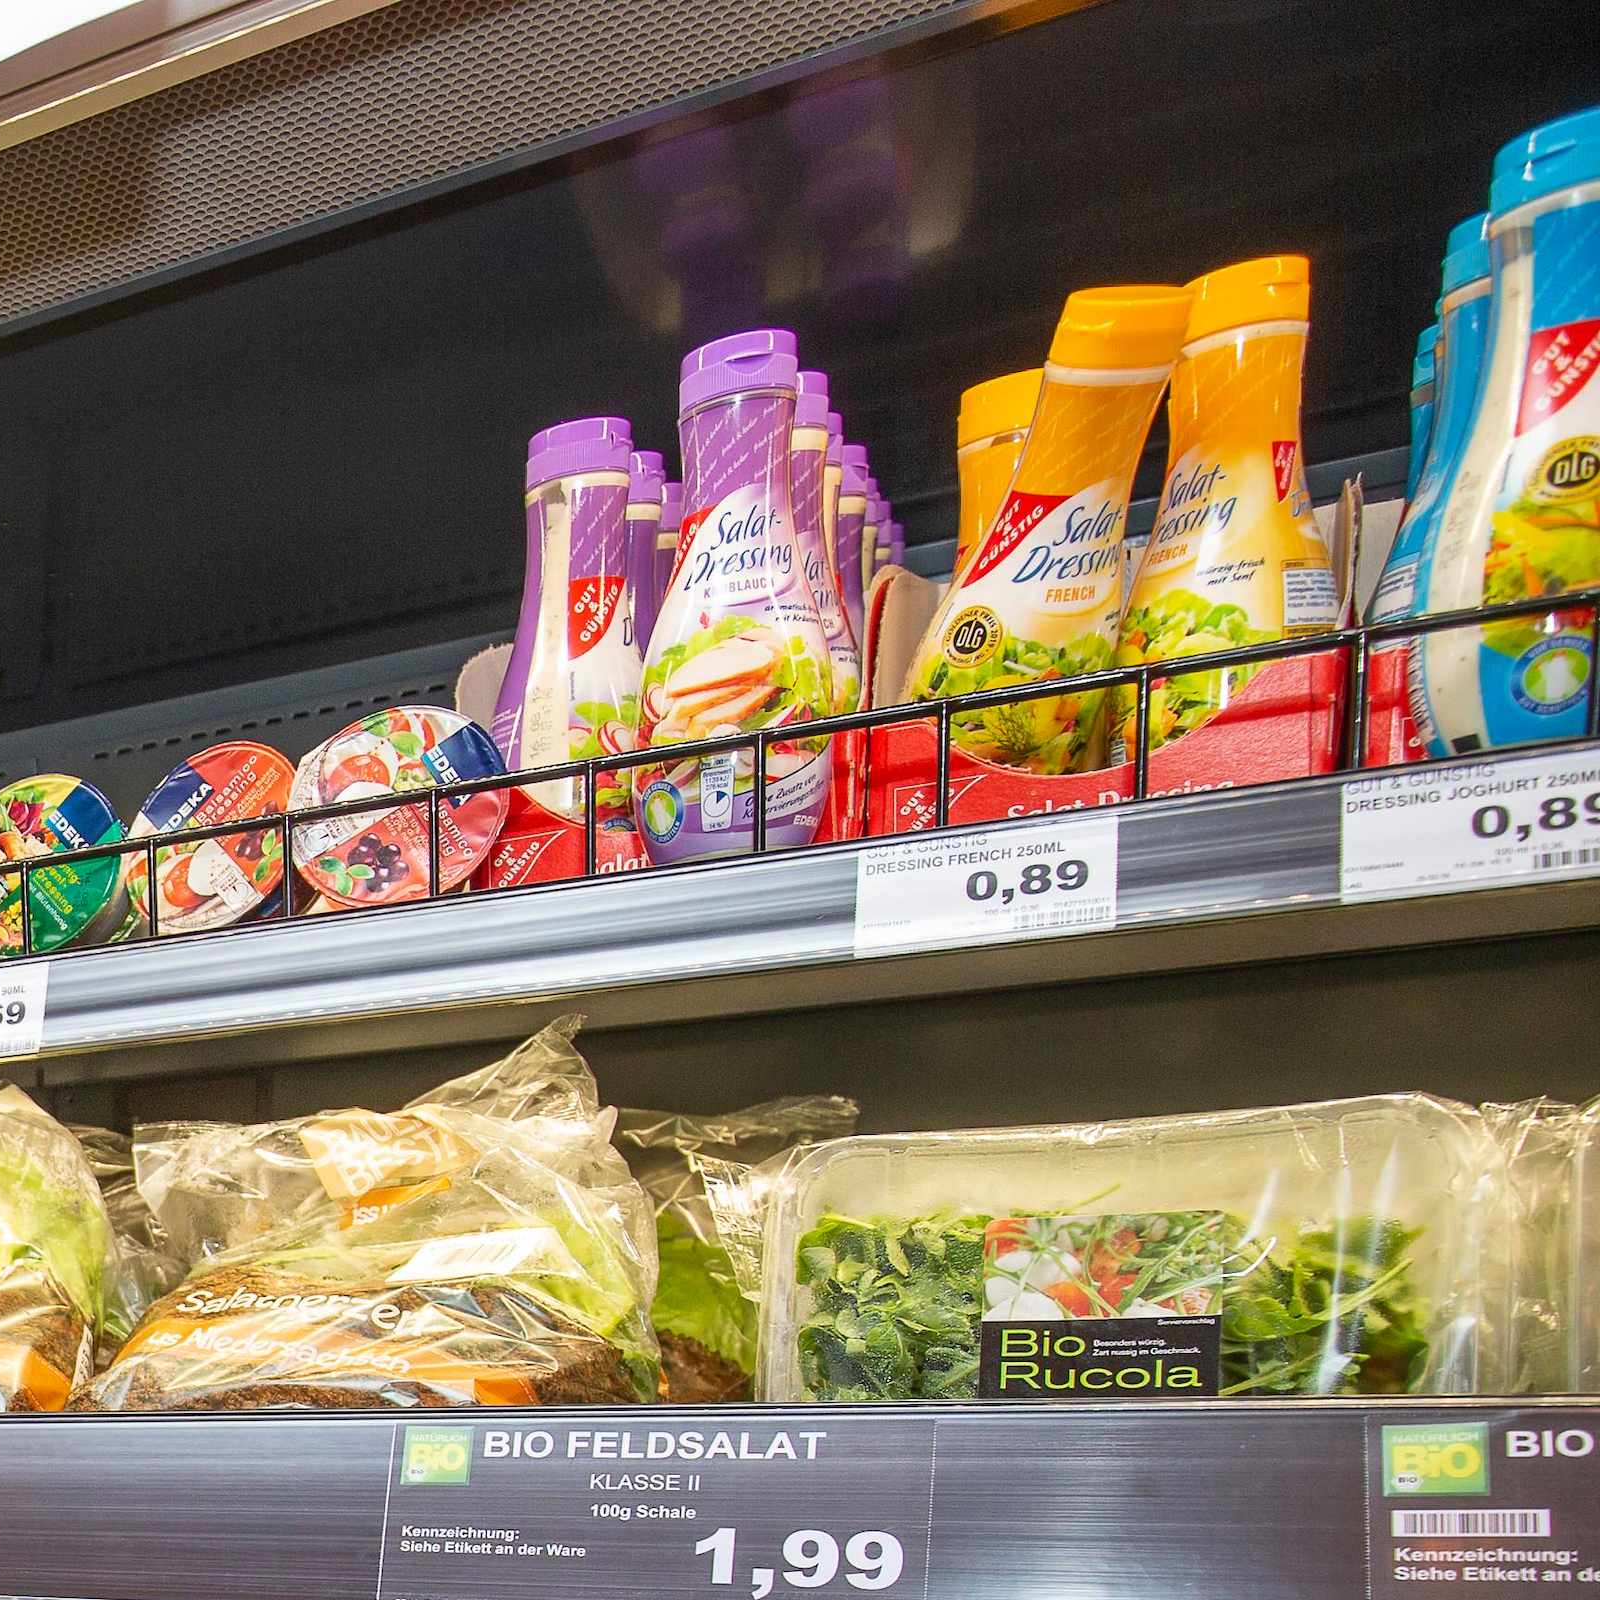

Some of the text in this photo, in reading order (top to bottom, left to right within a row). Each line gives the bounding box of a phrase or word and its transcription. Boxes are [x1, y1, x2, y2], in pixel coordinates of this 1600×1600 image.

[1553, 451, 1597, 485] DLG
[1162, 464, 1227, 515] Salat-
[711, 505, 783, 550] Salat-
[979, 503, 1045, 570] GÜNSTIG
[1053, 500, 1123, 547] Salat-
[1012, 540, 1123, 584] Dressing
[1045, 585, 1096, 603] FRENCH
[953, 617, 984, 648] DLG
[195, 755, 257, 821] Balsamico
[1346, 777, 1539, 814] DRESSING JOGHURT
[865, 841, 1066, 877] DRESSING FRENCH 250ML
[965, 859, 1090, 905] 0,89
[1000, 1328, 1086, 1358] Bio
[1093, 1339, 1137, 1347] Besonders
[999, 1359, 1203, 1390] Rucola
[482, 1430, 828, 1461] BIO FELDSALAT
[1506, 1429, 1594, 1458] BIO
[589, 1473, 683, 1492] KLASSE
[590, 1503, 697, 1521] 100g Schale
[399, 1539, 586, 1558] Siehe Etikett Ware
[401, 1525, 521, 1542] Kennzeichnung:
[694, 1526, 905, 1600] 1,99
[1394, 1548, 1578, 1565] Kennzeichnung:
[1394, 1566, 1537, 1582] Siehe Etikett
